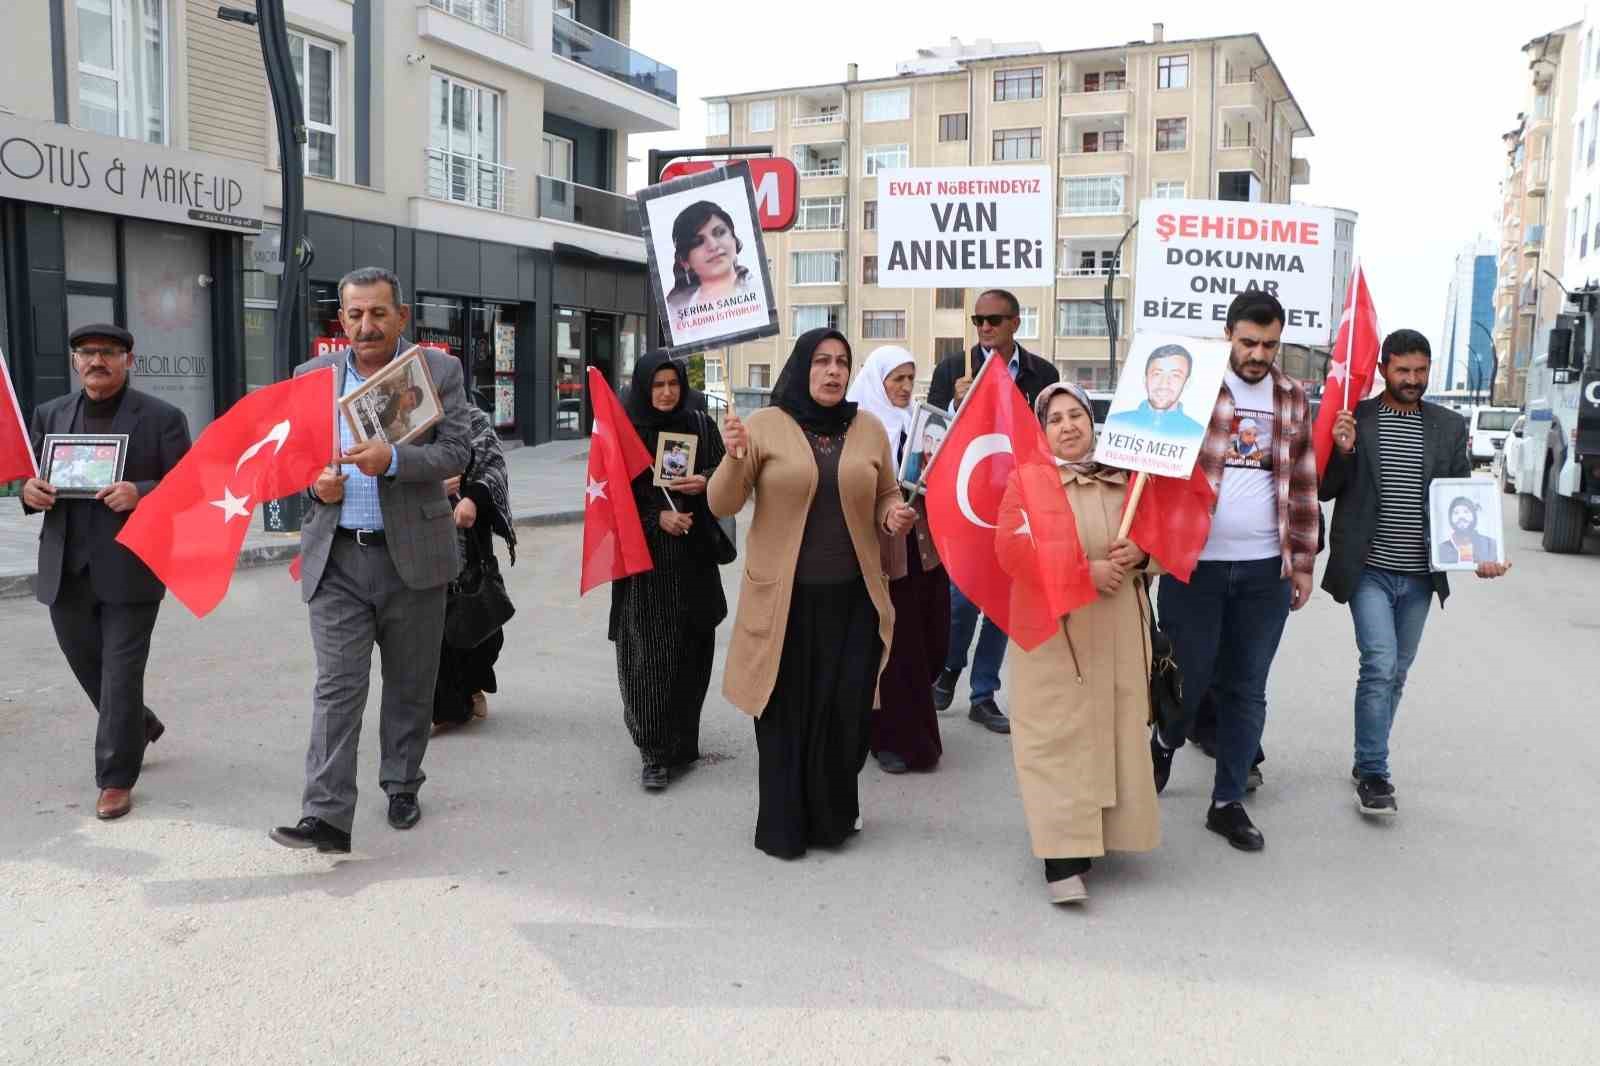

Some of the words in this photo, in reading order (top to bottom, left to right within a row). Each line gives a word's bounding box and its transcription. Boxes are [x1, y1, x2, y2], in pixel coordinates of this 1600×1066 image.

[0, 137, 91, 189] OTUS
[105, 158, 126, 195] &
[141, 164, 243, 213] MAKE-UP
[889, 182, 932, 196] EVLAT
[931, 202, 998, 232] VAN
[1166, 248, 1305, 273] DOKUNMA
[1190, 276, 1280, 298] ONLAR
[716, 291, 757, 308] SANCAR
[1143, 298, 1203, 320] BİZE
[174, 355, 209, 374] LOTUS
[1107, 431, 1144, 455] YETİŞ
[1146, 440, 1187, 460] MERT
